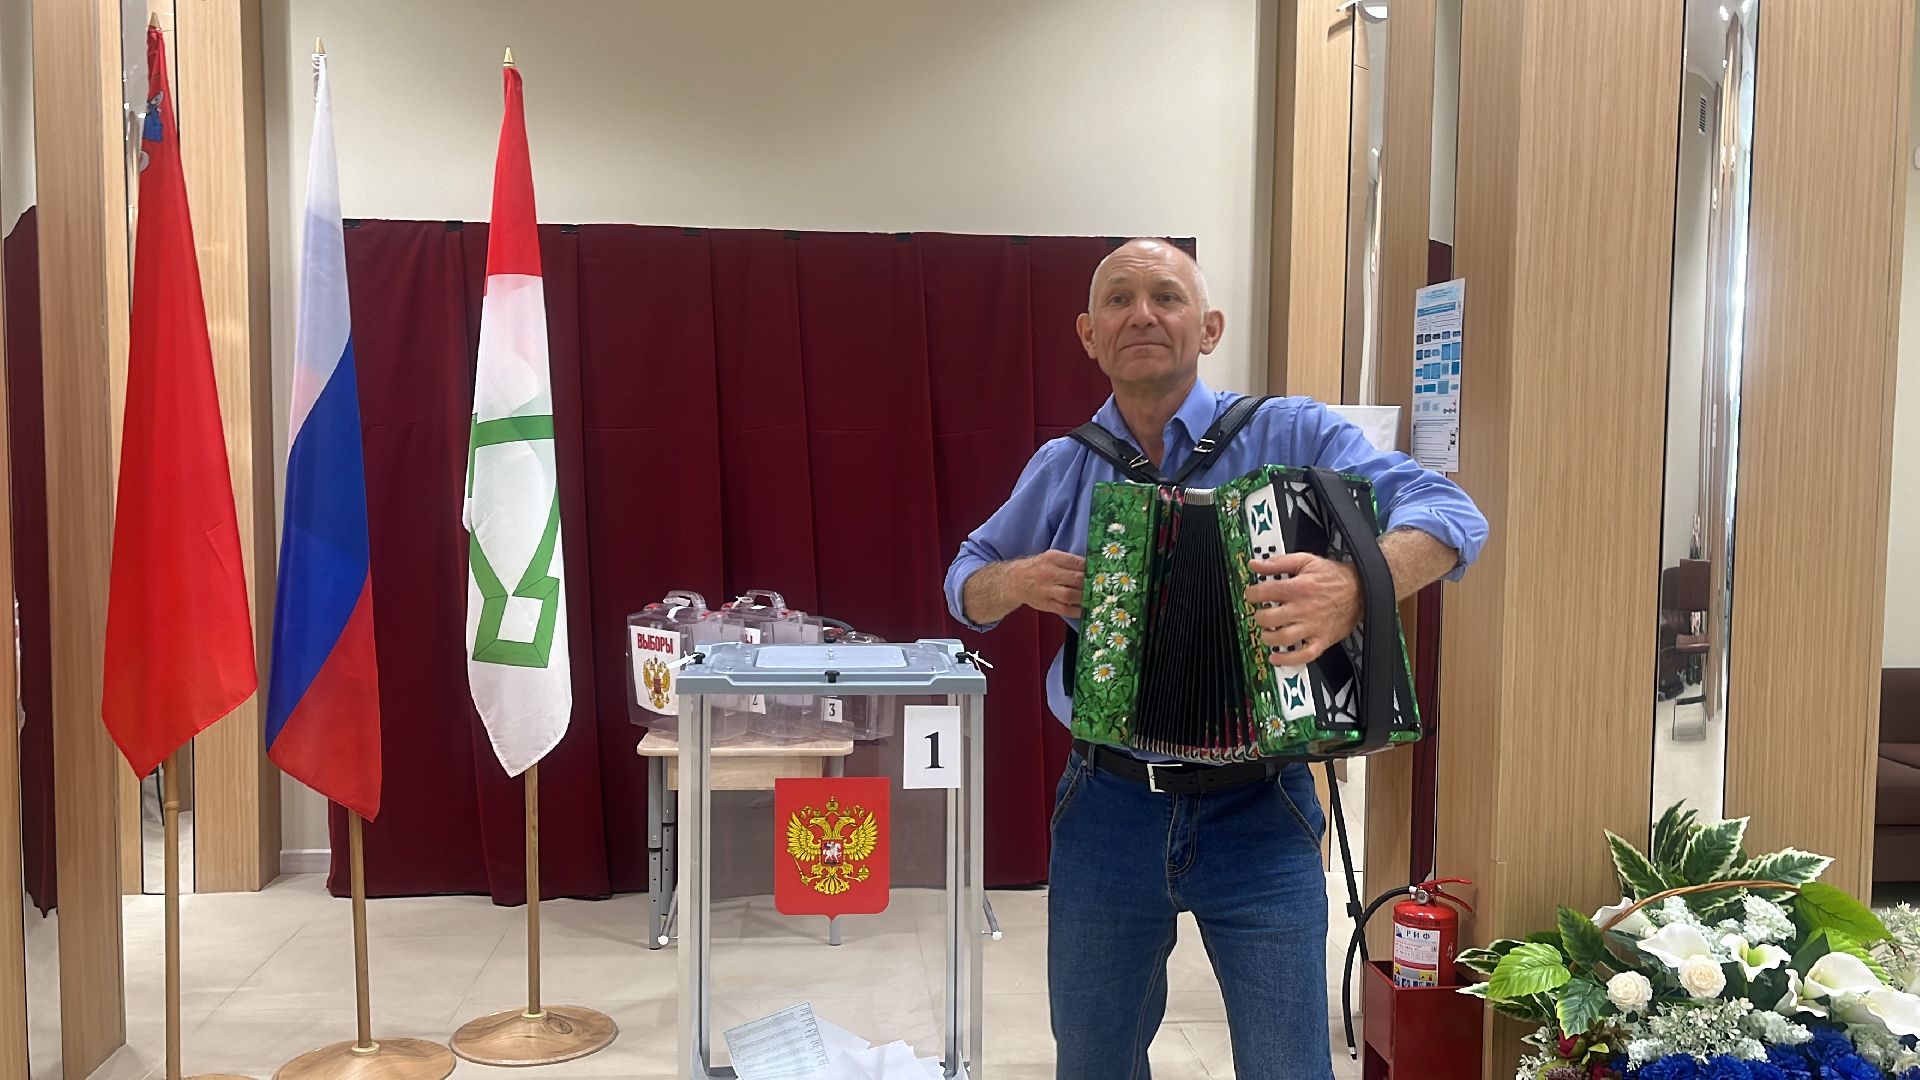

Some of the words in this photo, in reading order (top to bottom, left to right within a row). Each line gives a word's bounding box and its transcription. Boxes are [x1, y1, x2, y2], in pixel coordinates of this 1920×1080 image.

[1236, 552, 1267, 682] Туьская
[637, 633, 674, 654] ВЫБОРЫ
[829, 703, 836, 716] 3
[924, 731, 945, 769] 1
[1406, 930, 1431, 940] РИФ
